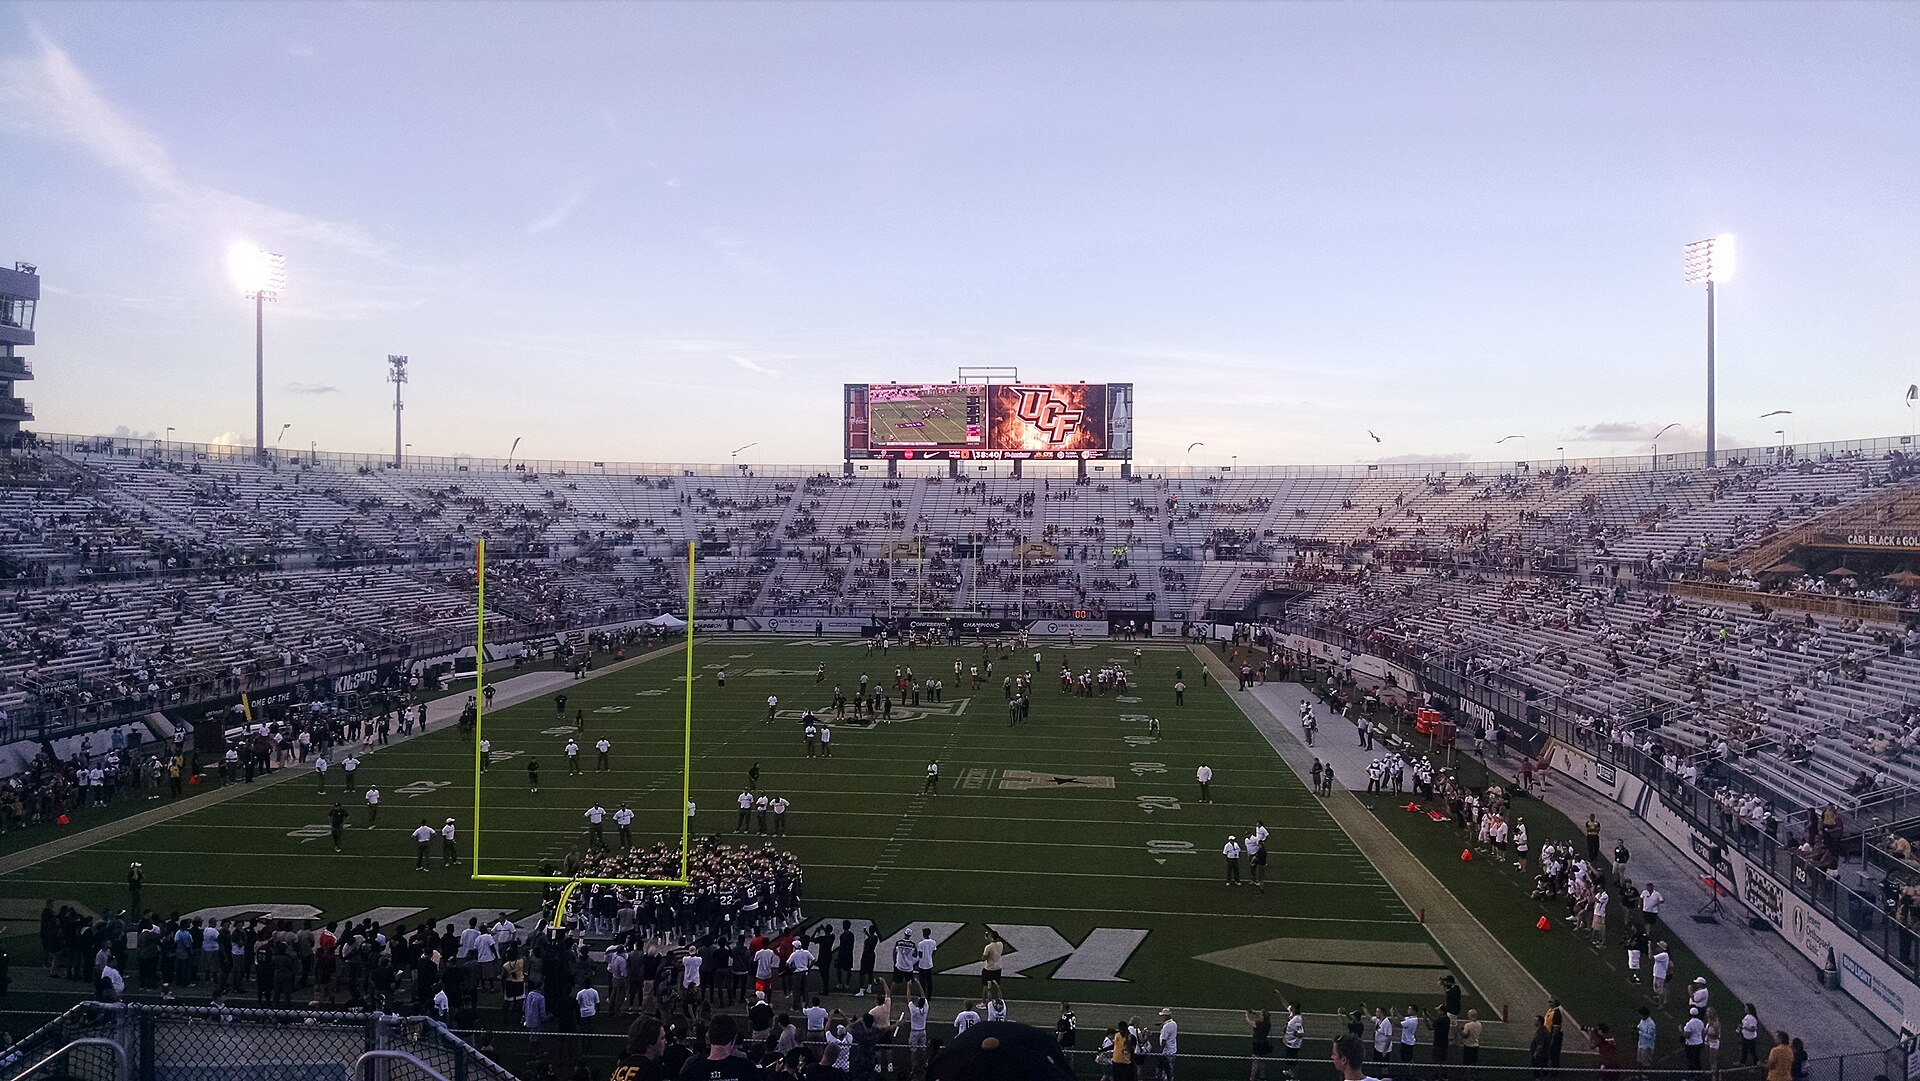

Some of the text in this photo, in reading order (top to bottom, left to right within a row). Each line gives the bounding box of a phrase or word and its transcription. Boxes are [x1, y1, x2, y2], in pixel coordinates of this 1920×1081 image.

[1009, 387, 1084, 445] UCF
[976, 452, 999, 460] 38:40
[1847, 535, 1868, 545] CARL
[1868, 535, 1895, 546] BLACK
[1896, 537, 1901, 546] &
[1075, 610, 1086, 619] 00
[962, 621, 1000, 630] CHAMPIONS
[334, 668, 378, 693] KNIGHTS
[251, 692, 291, 708] ONE OF THE
[1460, 696, 1495, 731] KNIGHTS
[635, 890, 644, 900] 11
[653, 893, 664, 905] 21
[720, 895, 733, 906] 22
[1854, 963, 1872, 988] LIGHT
